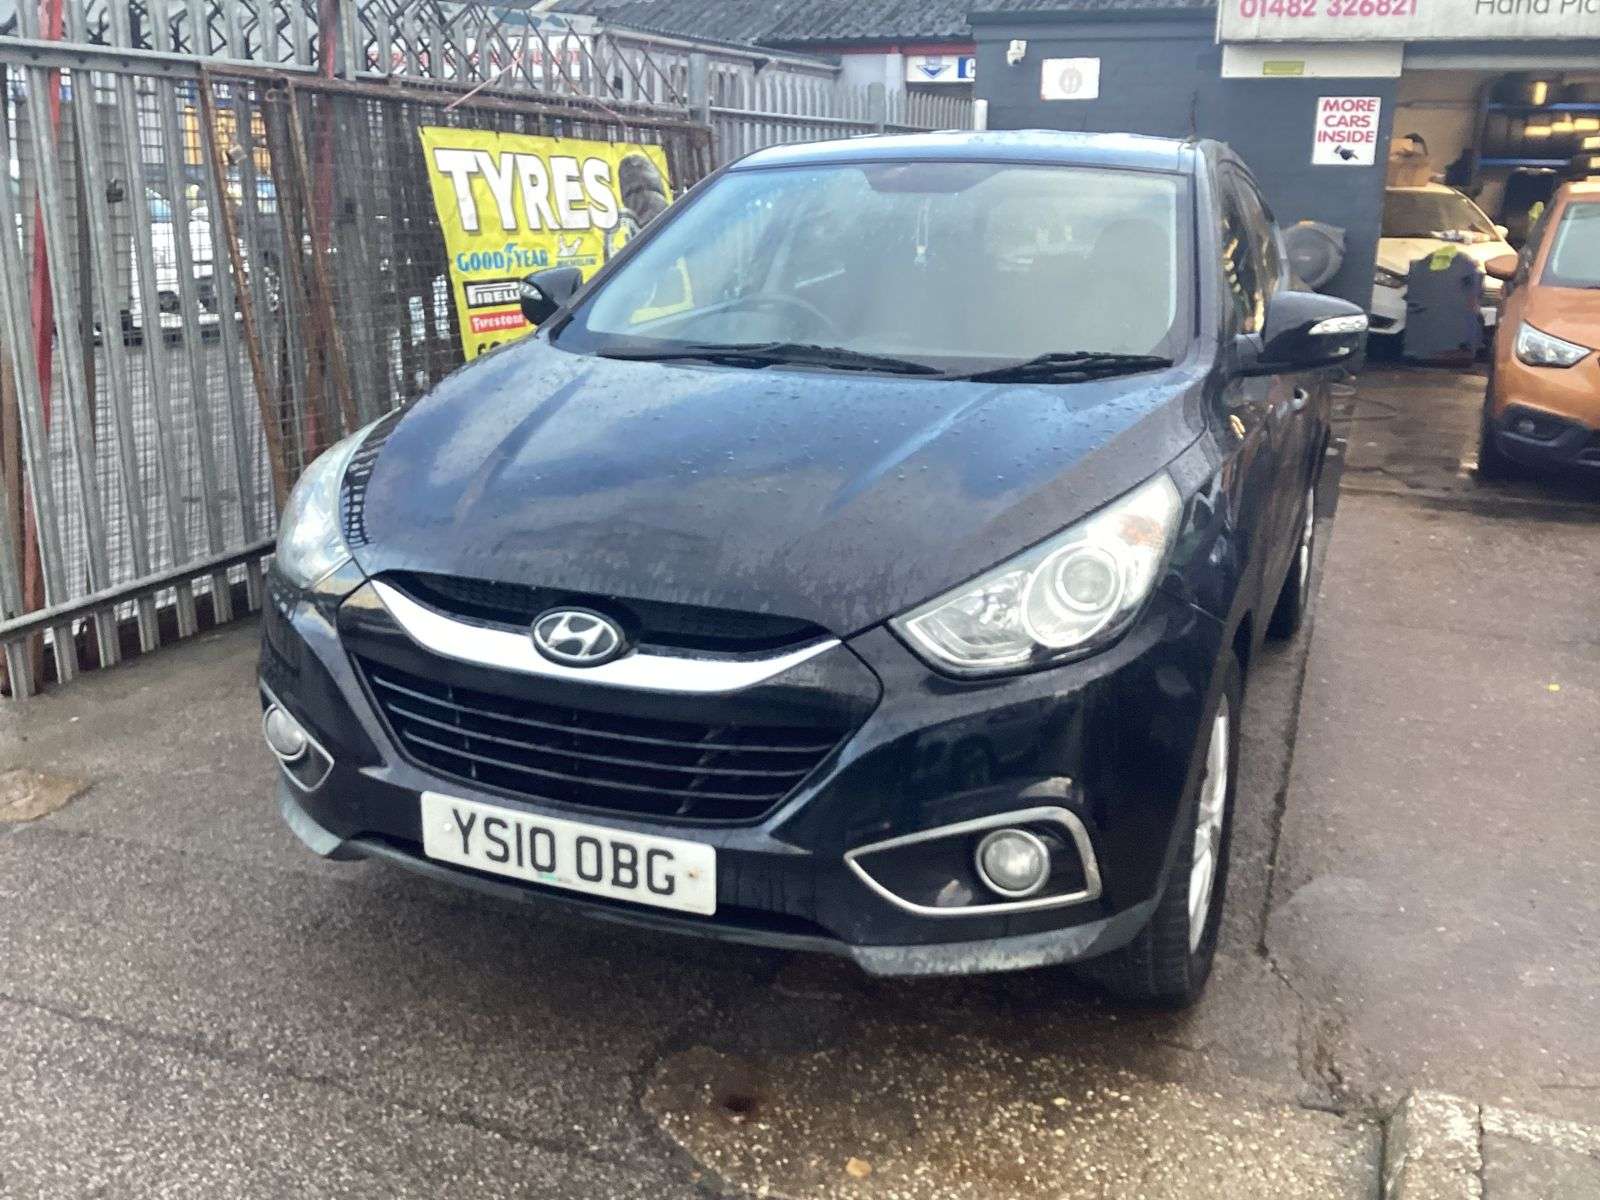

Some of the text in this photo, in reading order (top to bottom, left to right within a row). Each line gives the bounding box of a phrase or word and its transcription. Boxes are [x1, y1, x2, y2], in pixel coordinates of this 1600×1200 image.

[1240, 0, 1416, 17] 01482 326821
[1475, 0, 1550, 14] Hand
[1323, 99, 1376, 111] MORE
[1324, 115, 1370, 127] CARS
[1317, 130, 1374, 143] INSIDE
[433, 147, 619, 232] TYRES
[452, 808, 676, 896] YS10 OBG
